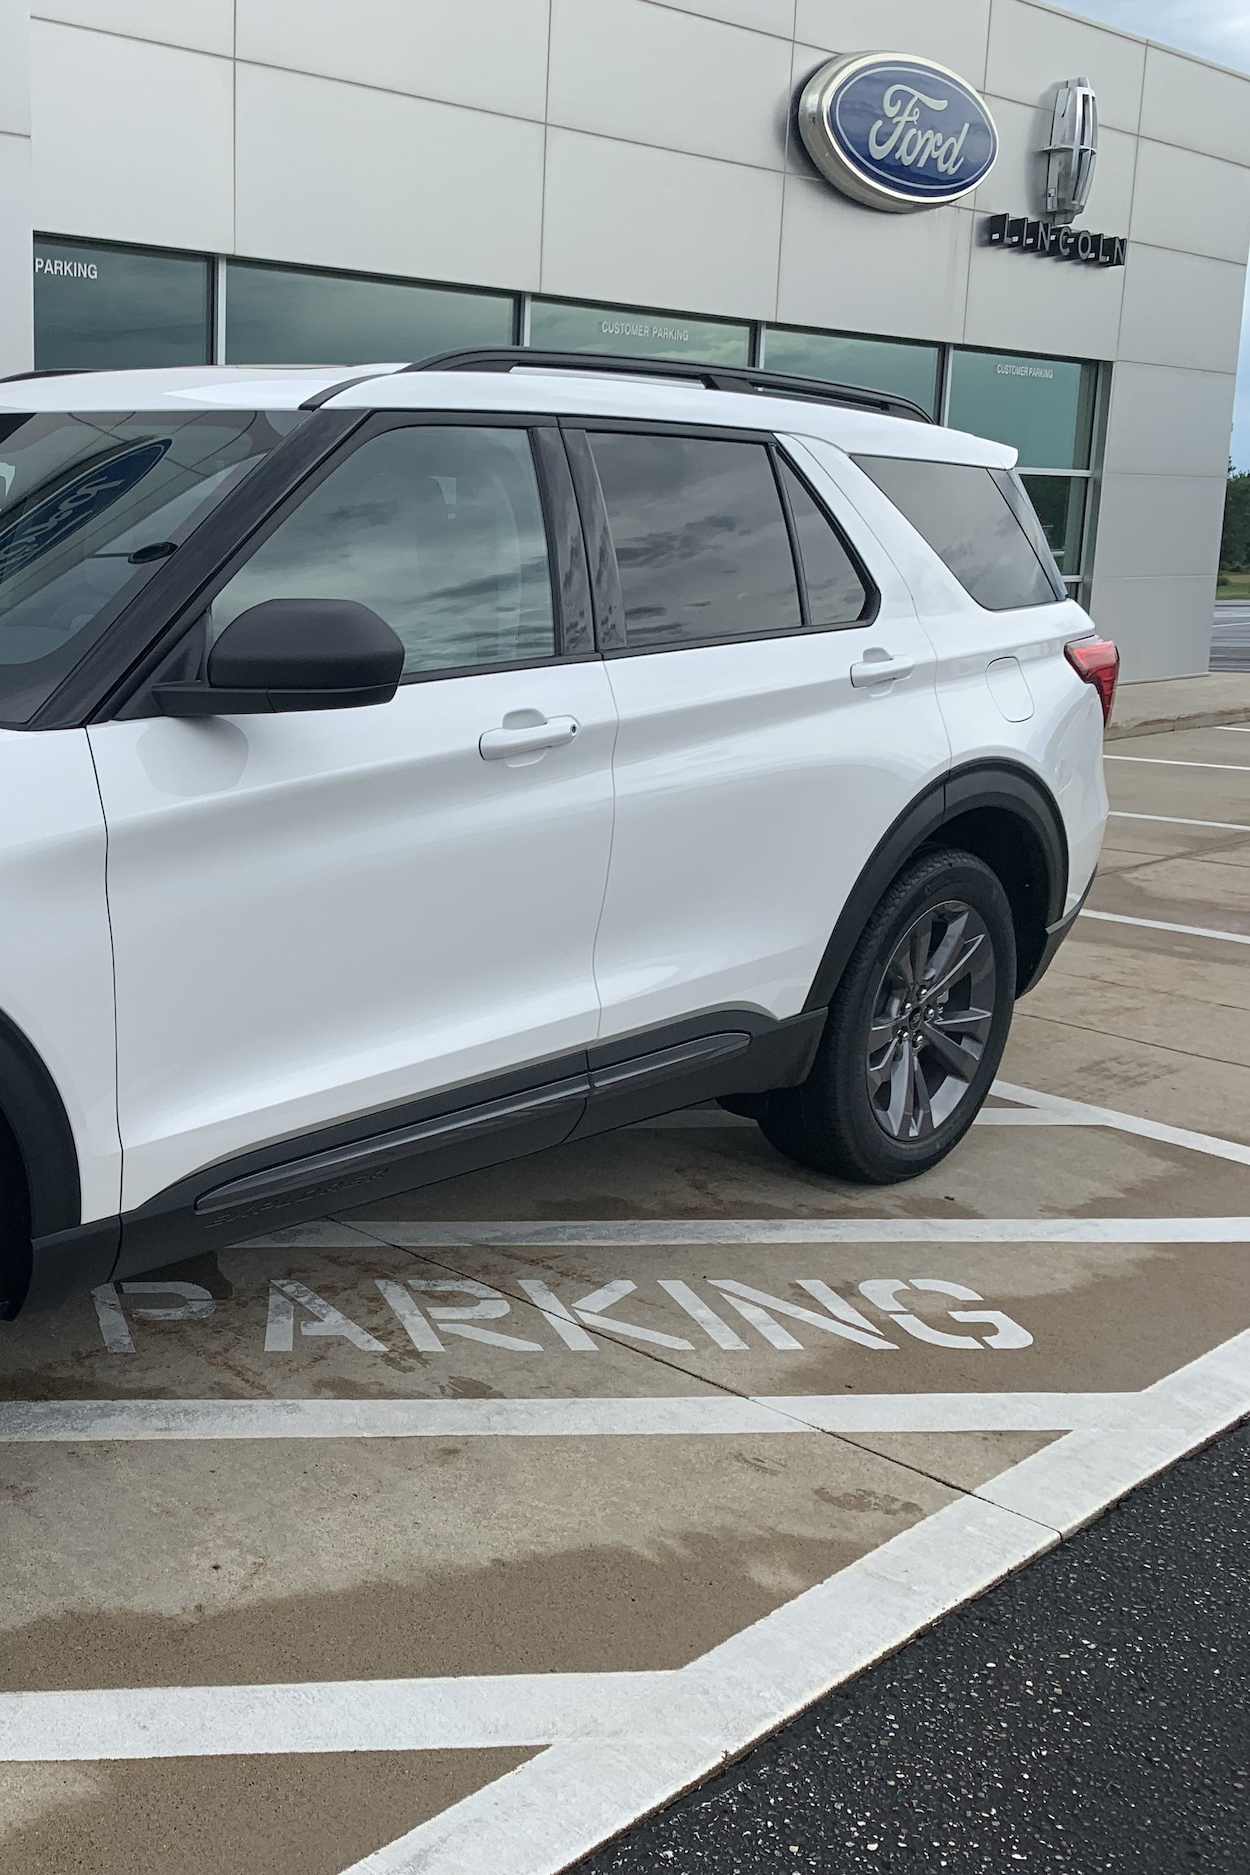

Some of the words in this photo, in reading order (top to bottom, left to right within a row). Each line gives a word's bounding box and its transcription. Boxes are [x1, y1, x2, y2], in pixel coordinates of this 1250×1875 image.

[868, 84, 970, 175] Ford
[1000, 212, 1128, 266] LINCOLN
[35, 258, 98, 280] PARKING
[601, 320, 650, 337] CUSTOMER
[652, 326, 689, 341] PARKING
[996, 363, 1028, 376] CUSTOMER
[1028, 367, 1053, 379] PARKING
[90, 1278, 1034, 1353] PARKING
